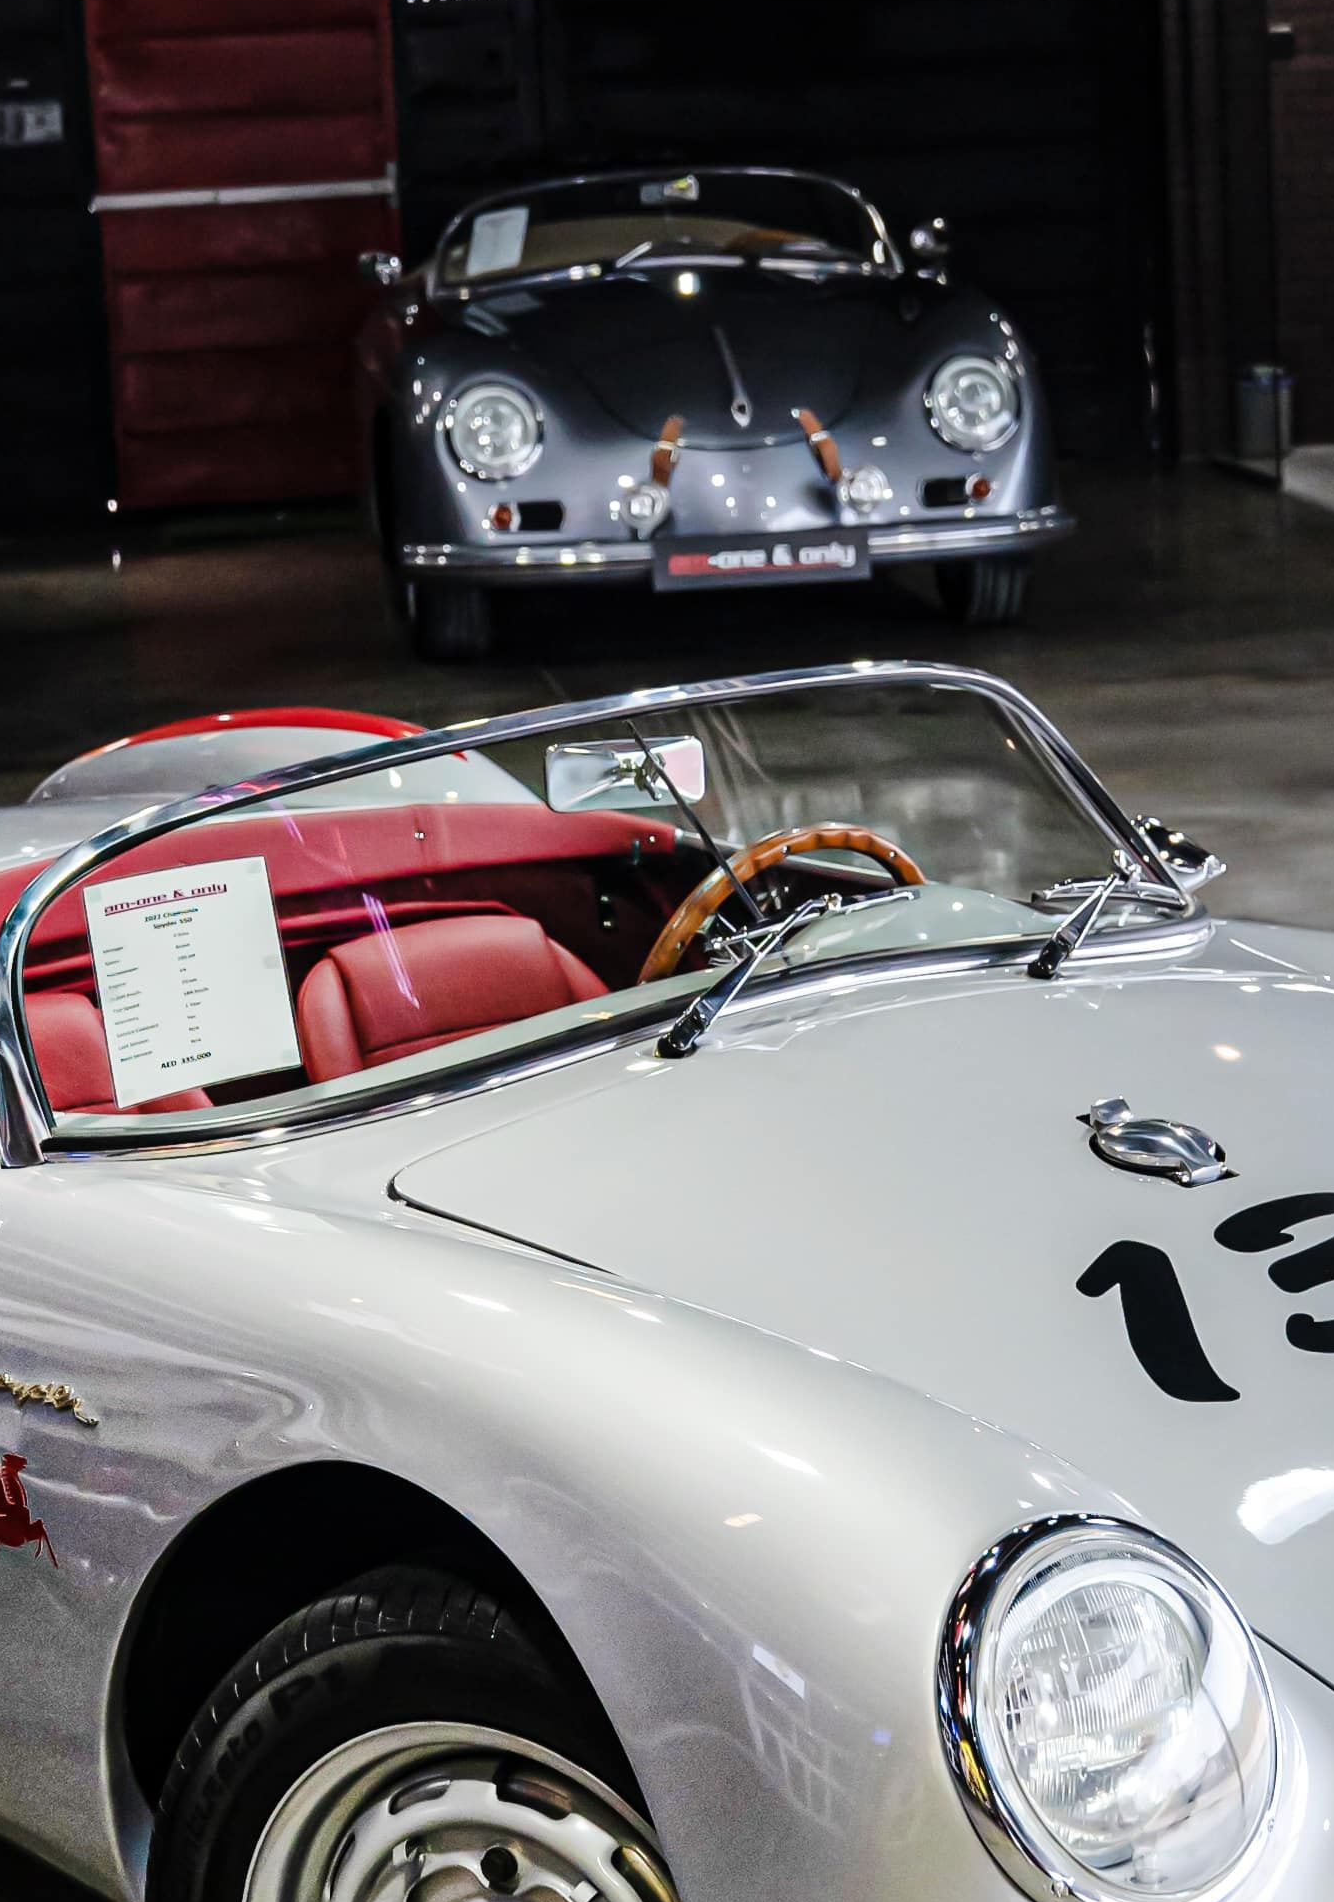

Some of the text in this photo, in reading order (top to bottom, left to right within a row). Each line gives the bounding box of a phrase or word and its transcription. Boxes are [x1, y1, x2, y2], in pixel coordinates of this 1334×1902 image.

[798, 542, 857, 569] only
[104, 893, 168, 915] am-one
[191, 883, 228, 898] only
[161, 1060, 177, 1069] AED
